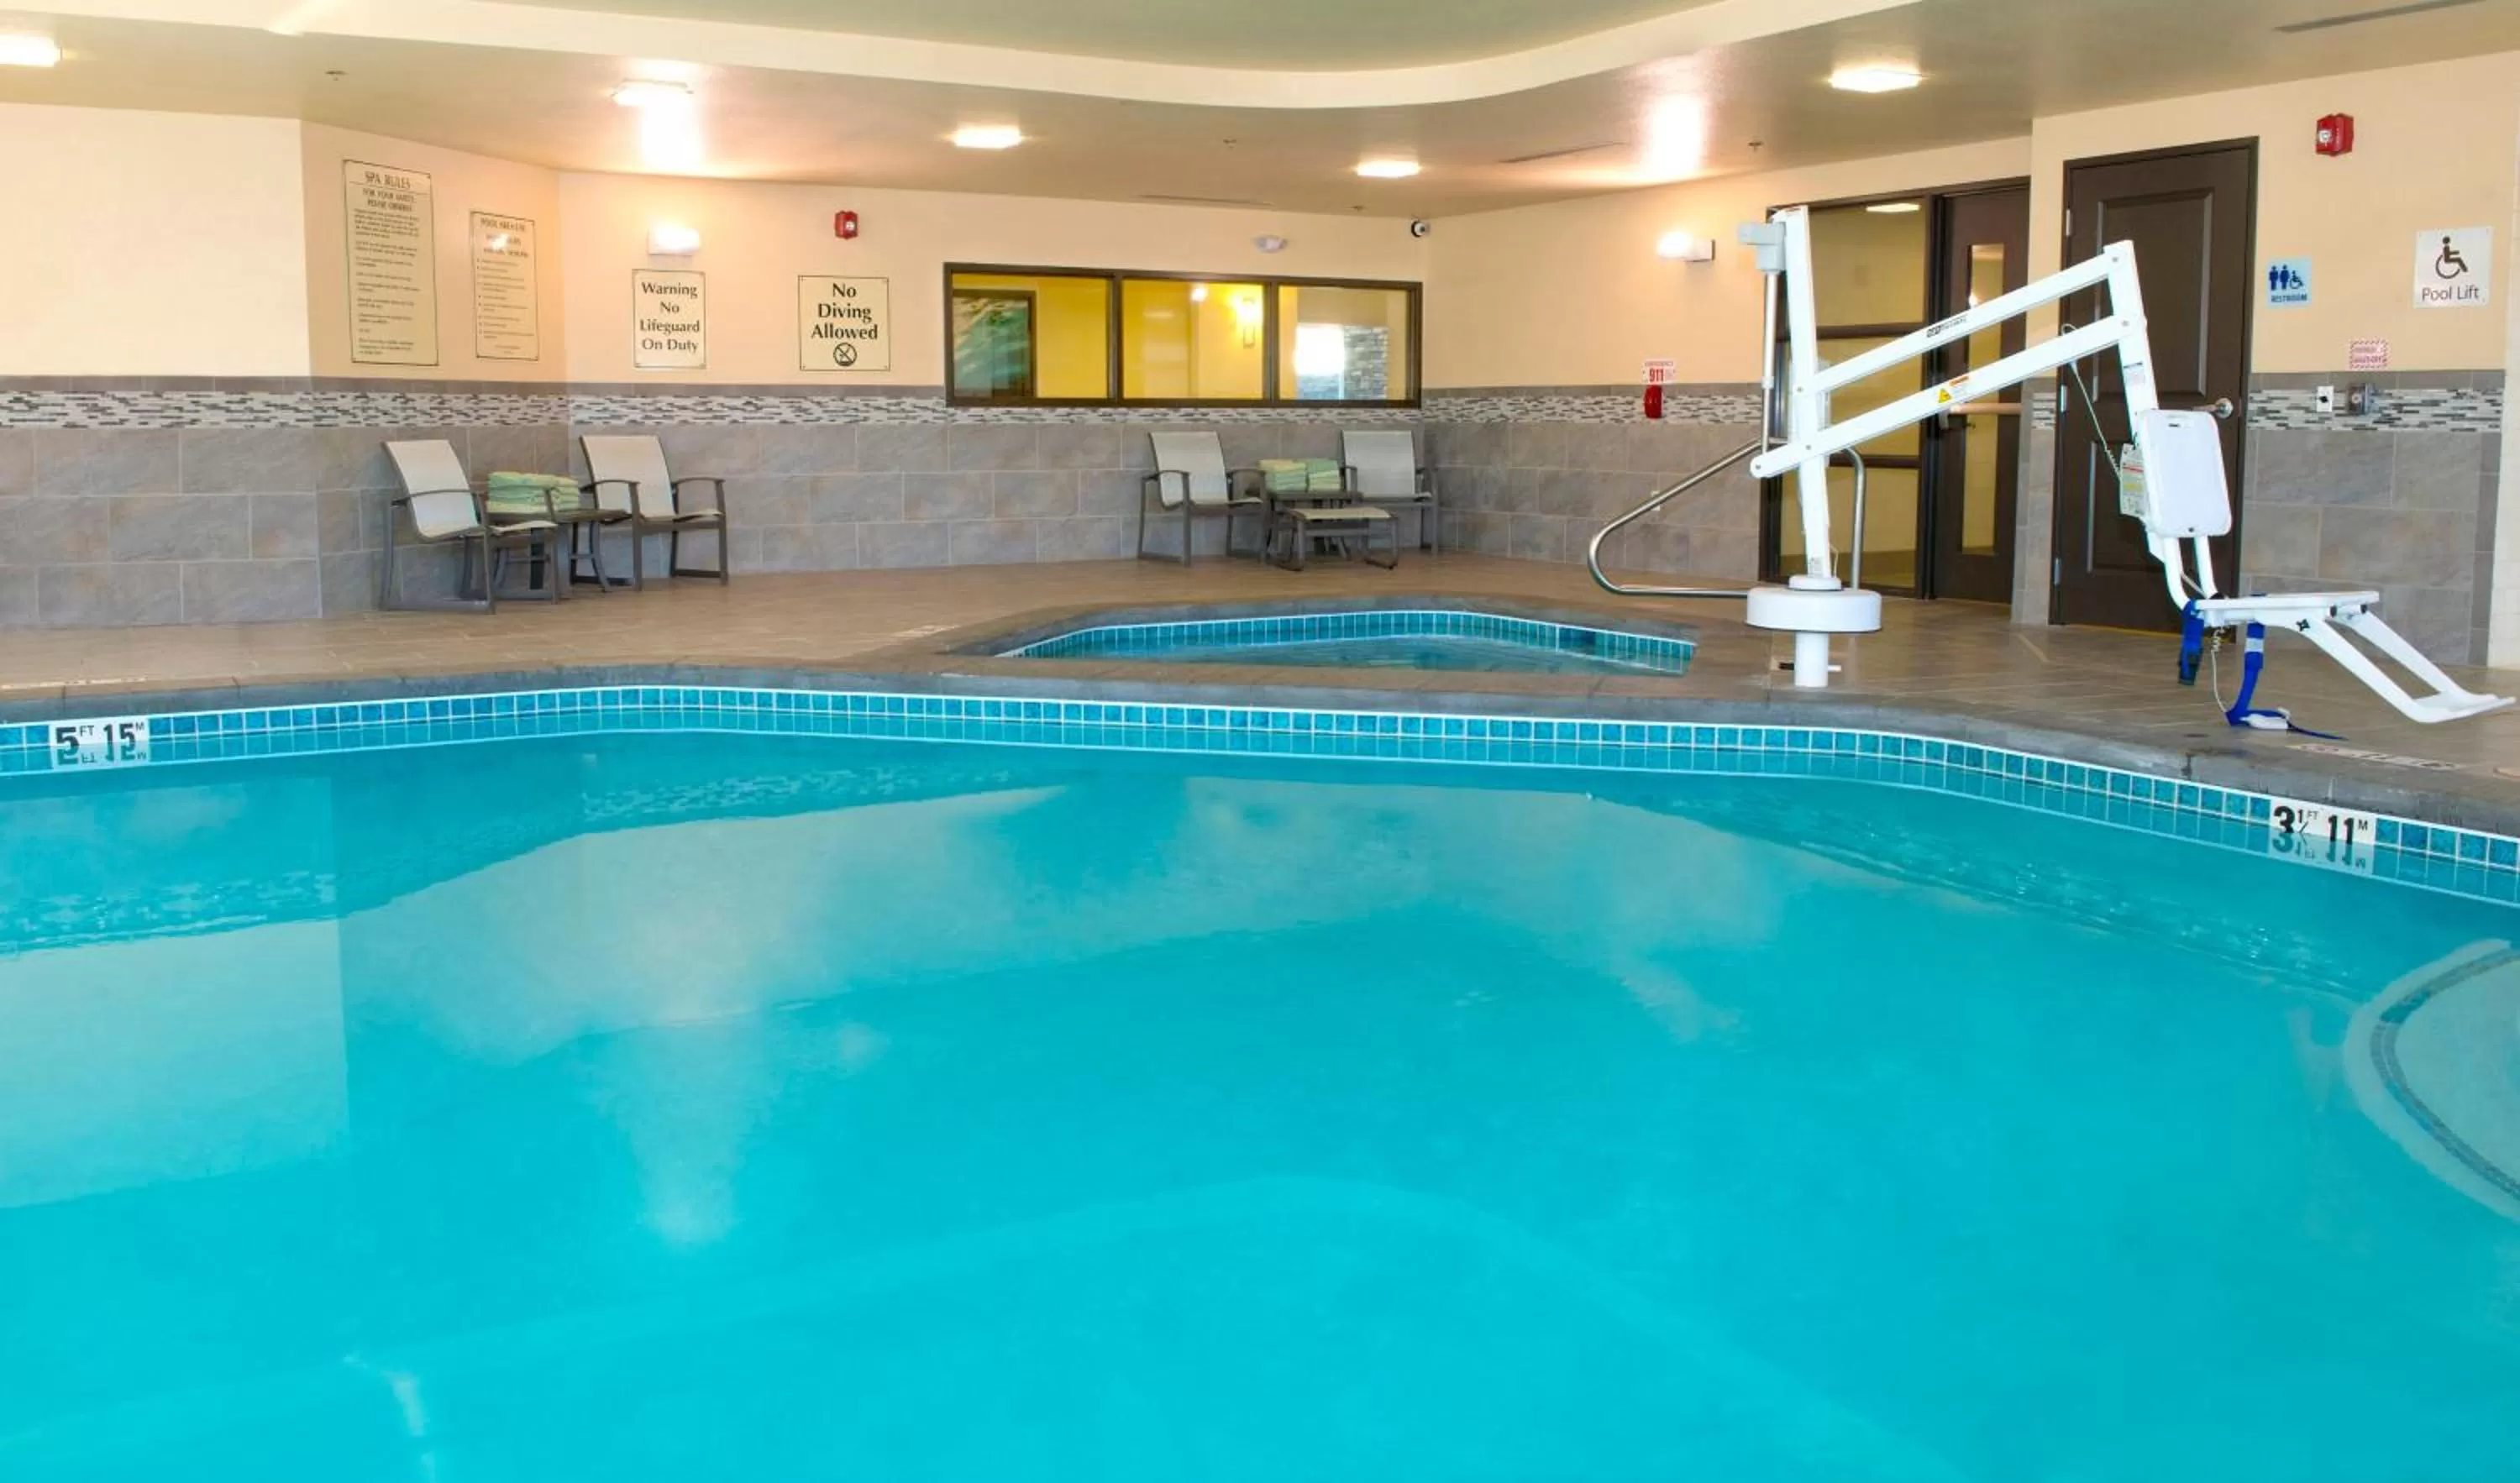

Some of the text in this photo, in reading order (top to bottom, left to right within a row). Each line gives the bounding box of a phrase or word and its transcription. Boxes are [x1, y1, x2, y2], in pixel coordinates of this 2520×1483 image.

[641, 282, 698, 297] Warning
[832, 283, 857, 297] No
[2422, 285, 2480, 301] Pool Lift
[659, 301, 680, 313] No
[817, 303, 873, 322] Diving
[639, 318, 701, 334] Lifeguard
[811, 323, 879, 340] Allowed
[641, 338, 699, 353] On Duty
[1649, 368, 1664, 382] 911
[2358, 820, 2368, 831] M
